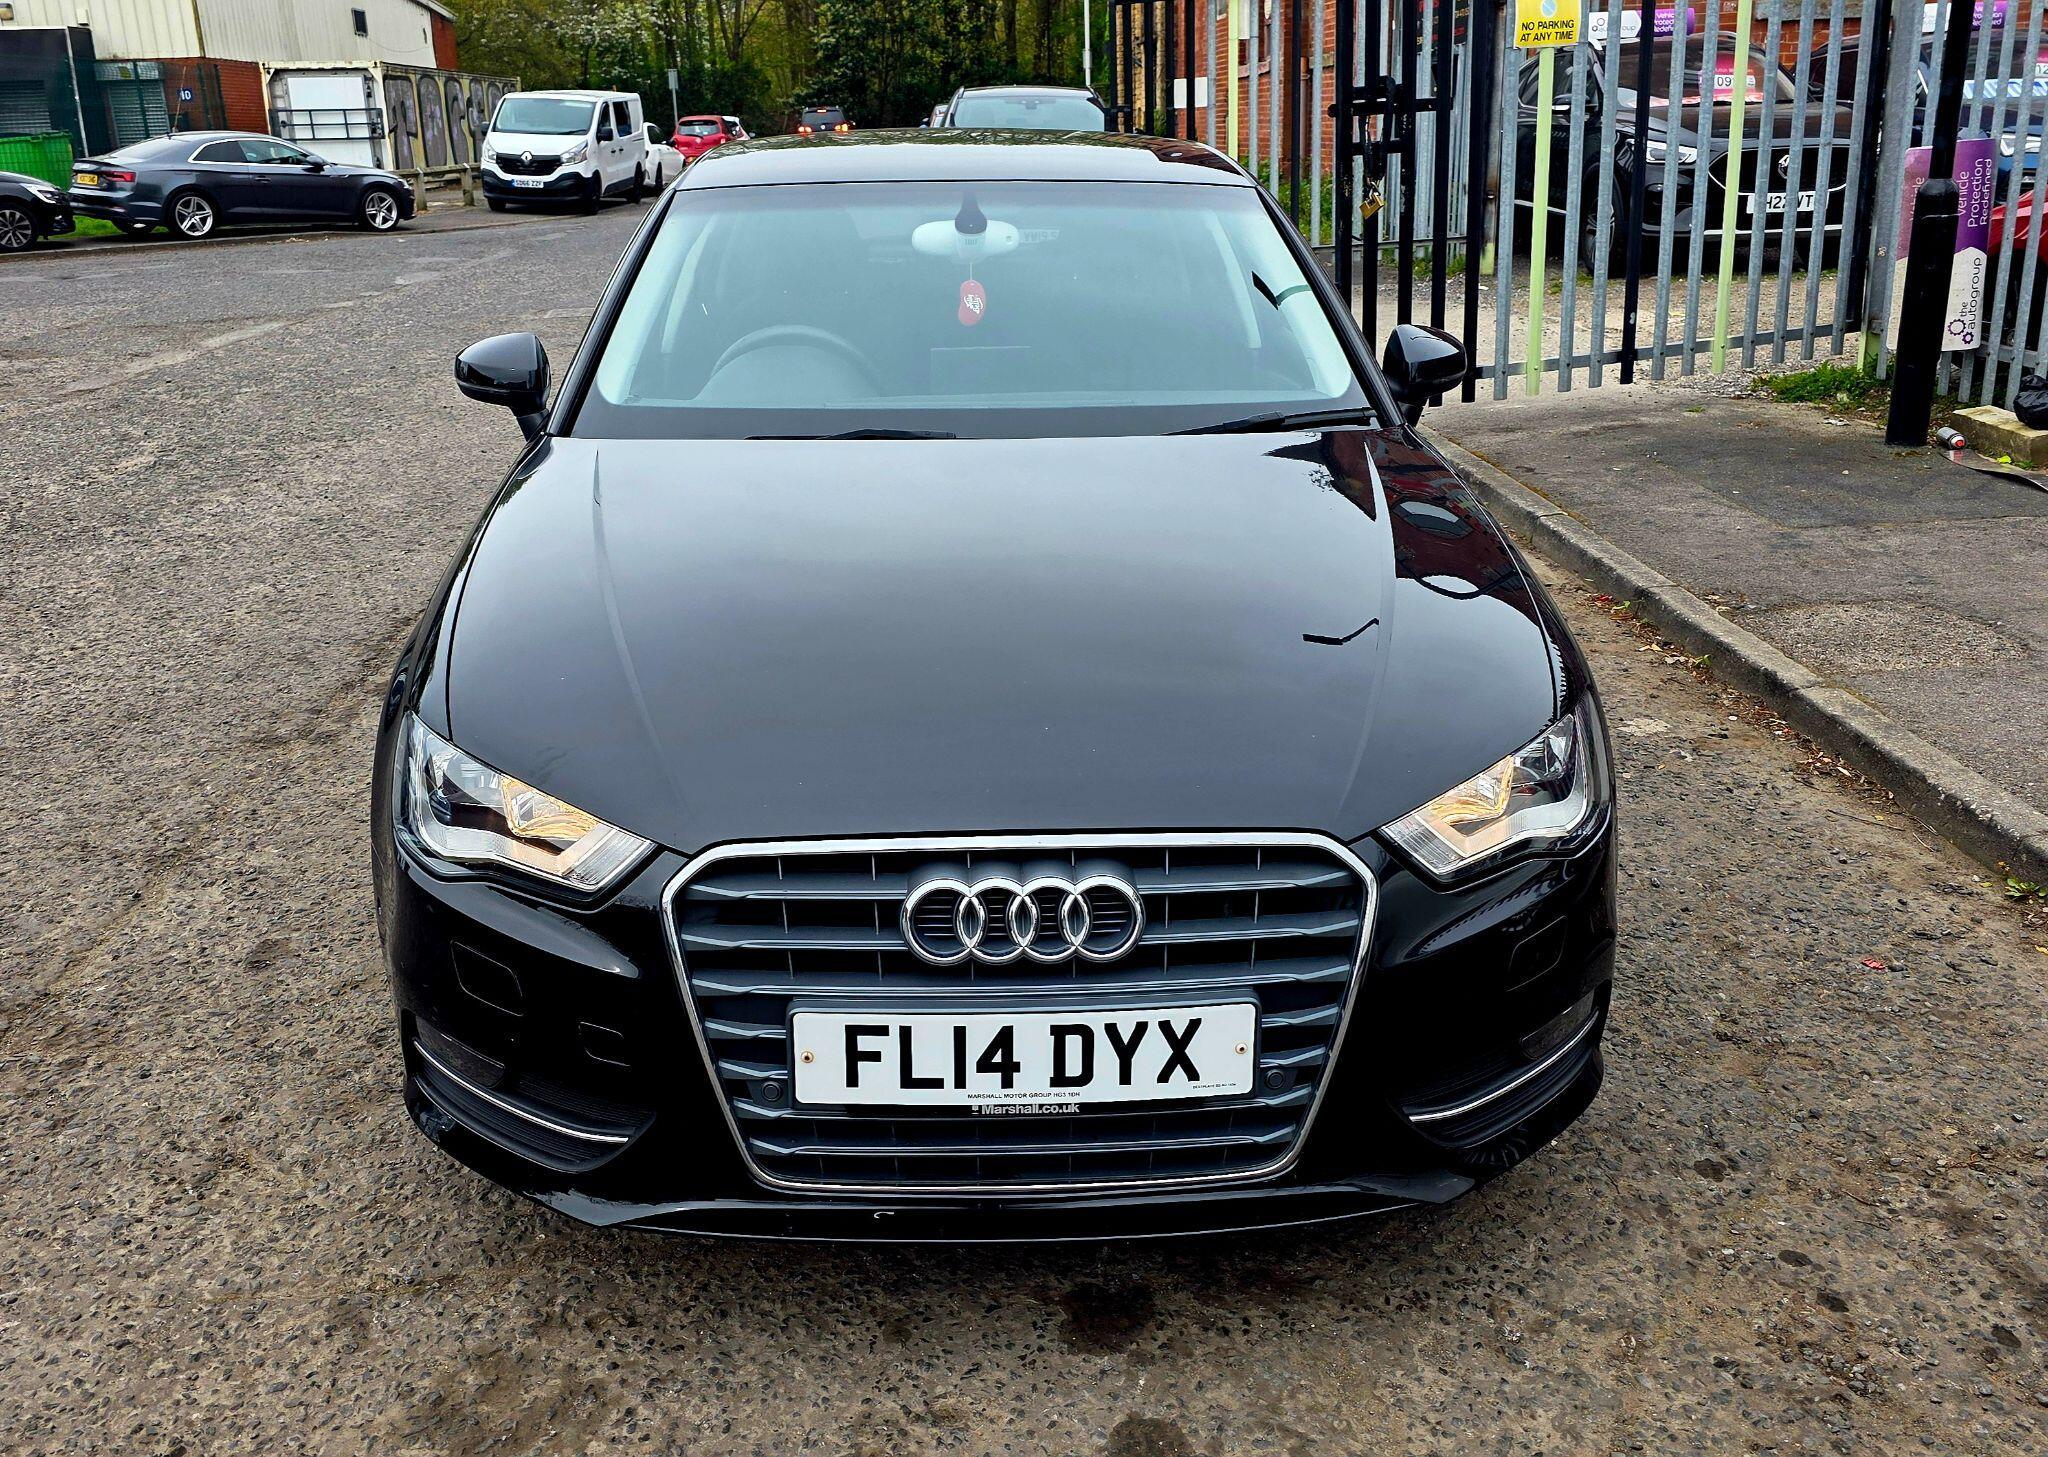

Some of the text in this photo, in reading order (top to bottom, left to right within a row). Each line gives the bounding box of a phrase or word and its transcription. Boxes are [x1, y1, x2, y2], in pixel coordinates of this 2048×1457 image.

[1521, 19, 1575, 31] NO PARKING
[1520, 30, 1573, 42] AT ANY TIME
[180, 90, 192, 100] 10
[1967, 157, 1984, 228] Protection
[1979, 158, 1993, 225] Redefined
[1967, 257, 1982, 330] autogroup
[1958, 301, 1968, 317] the
[845, 1017, 1203, 1089] FL14 DYX
[981, 1103, 1080, 1115] Marshall.co.uk
